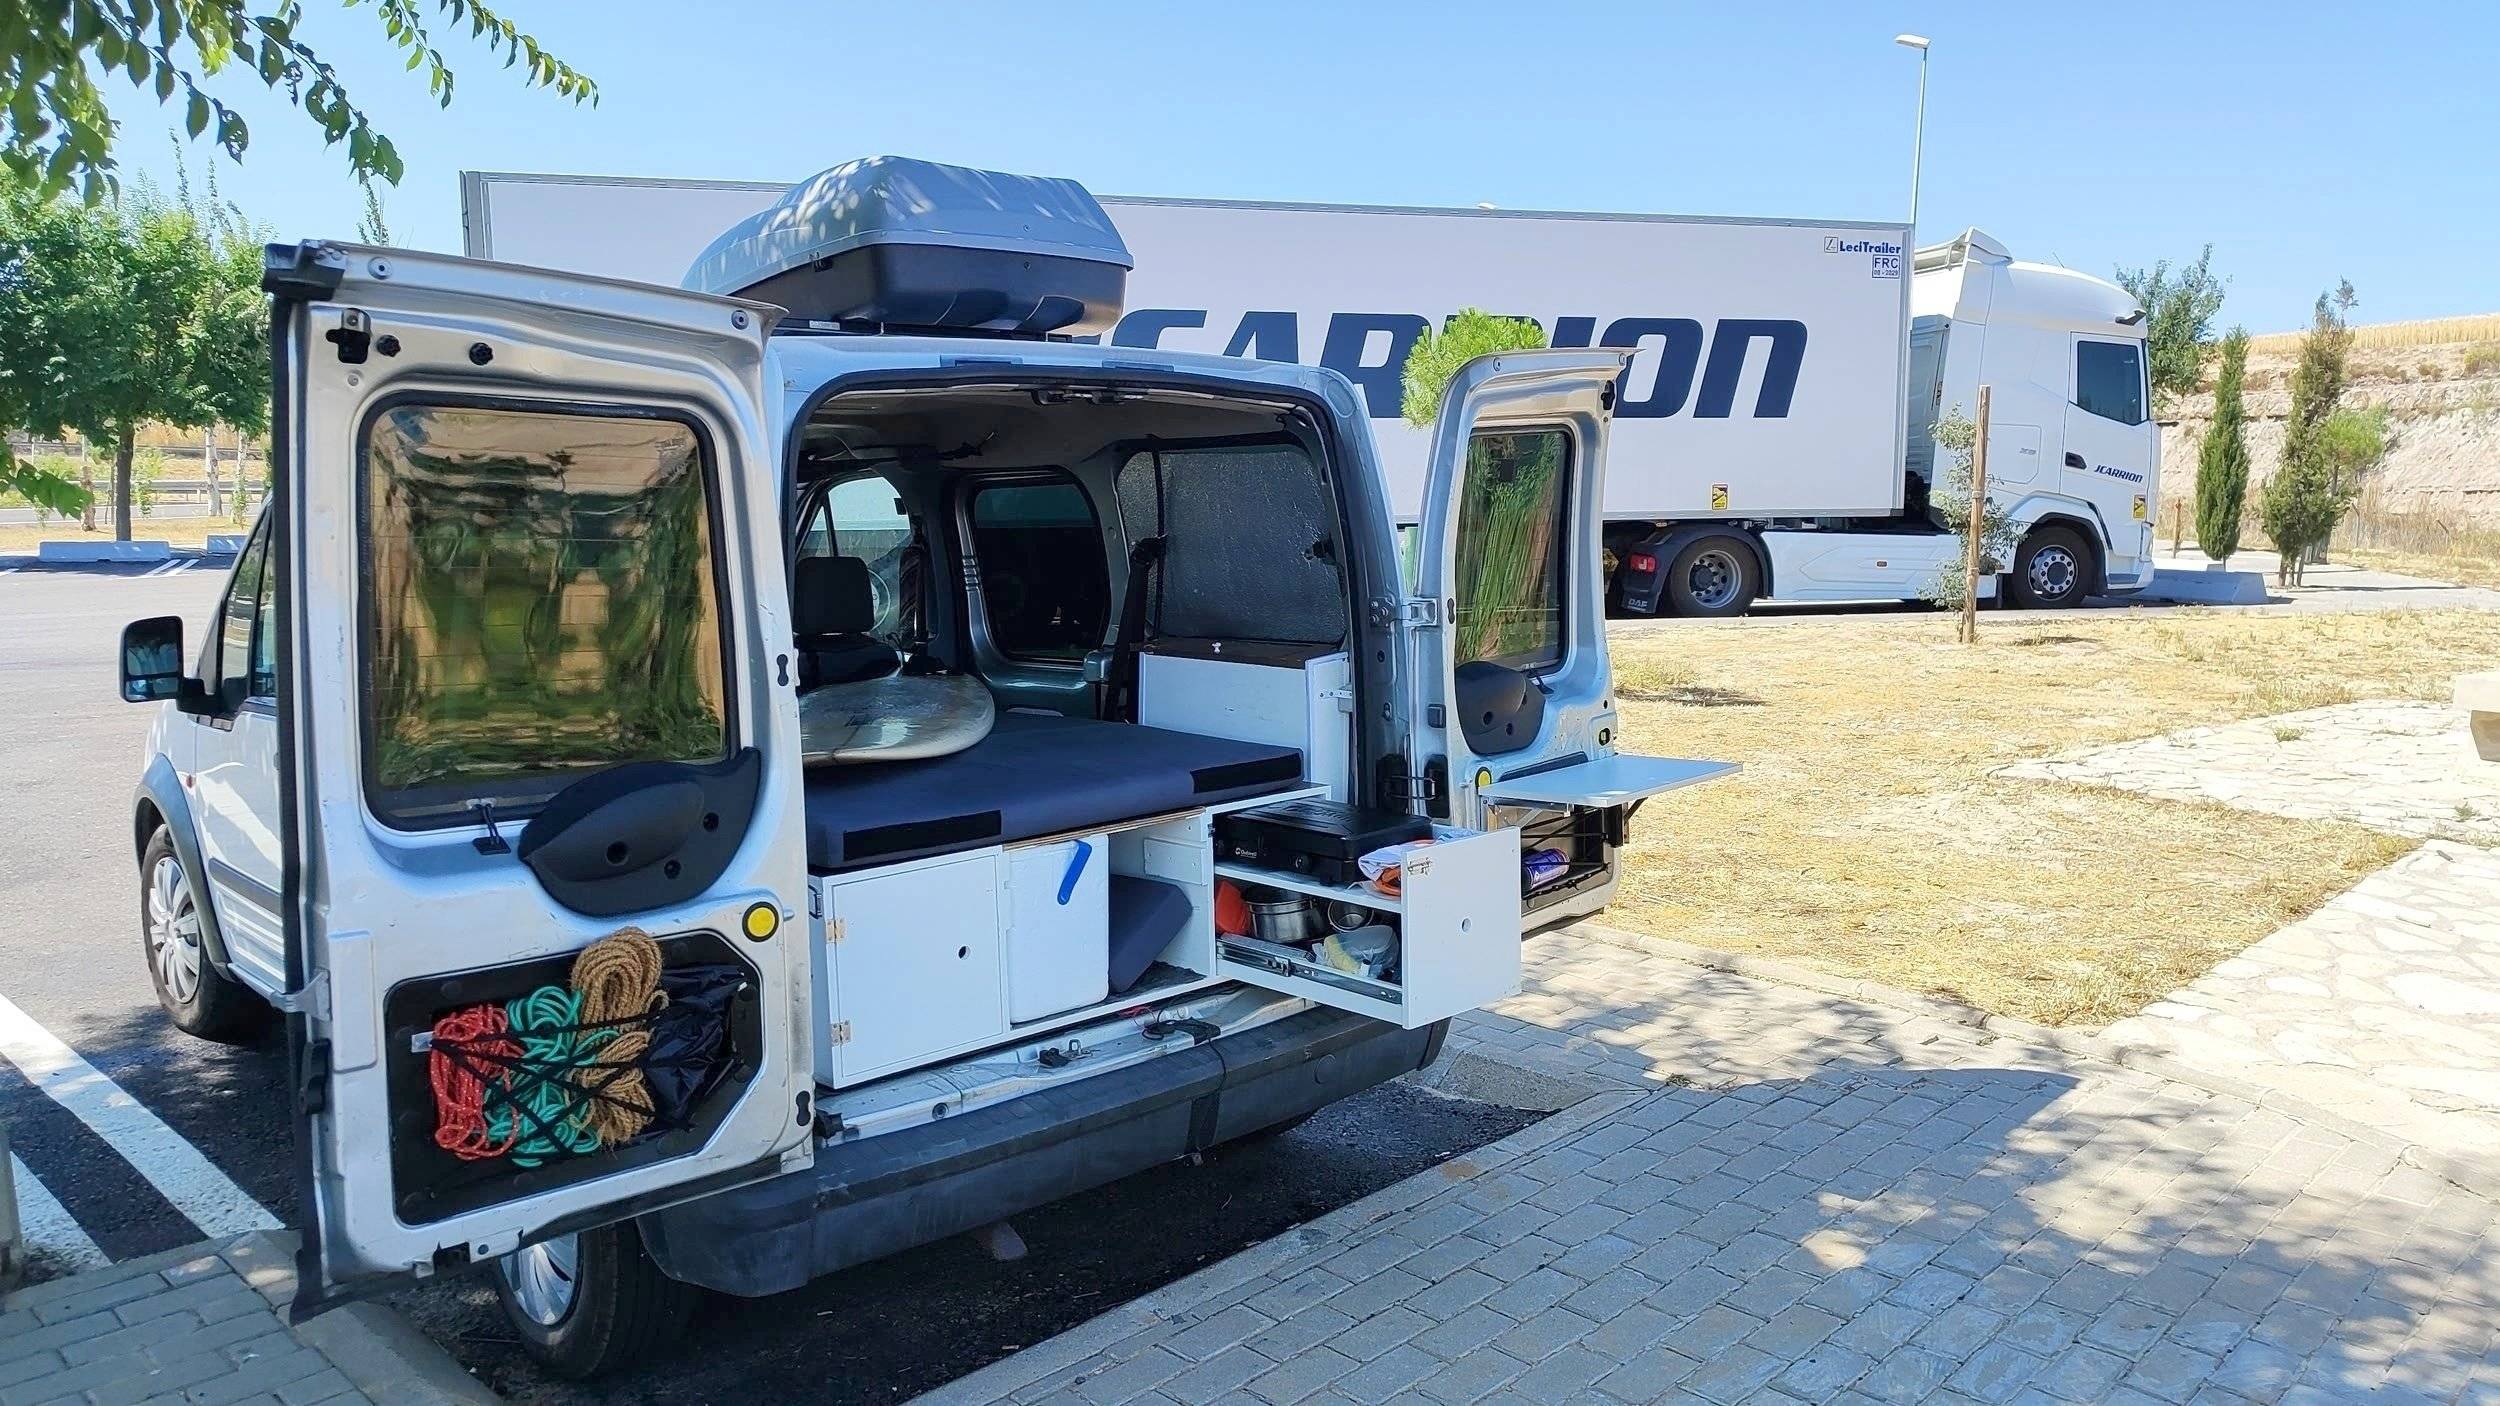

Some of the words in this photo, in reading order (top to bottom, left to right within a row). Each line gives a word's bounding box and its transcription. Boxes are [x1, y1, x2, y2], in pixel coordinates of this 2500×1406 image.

[1839, 240, 1901, 254] LeciTrailer
[1874, 257, 1899, 269] FRC
[2093, 464, 2143, 483] JCARRION
[1628, 598, 1648, 607] DAF
